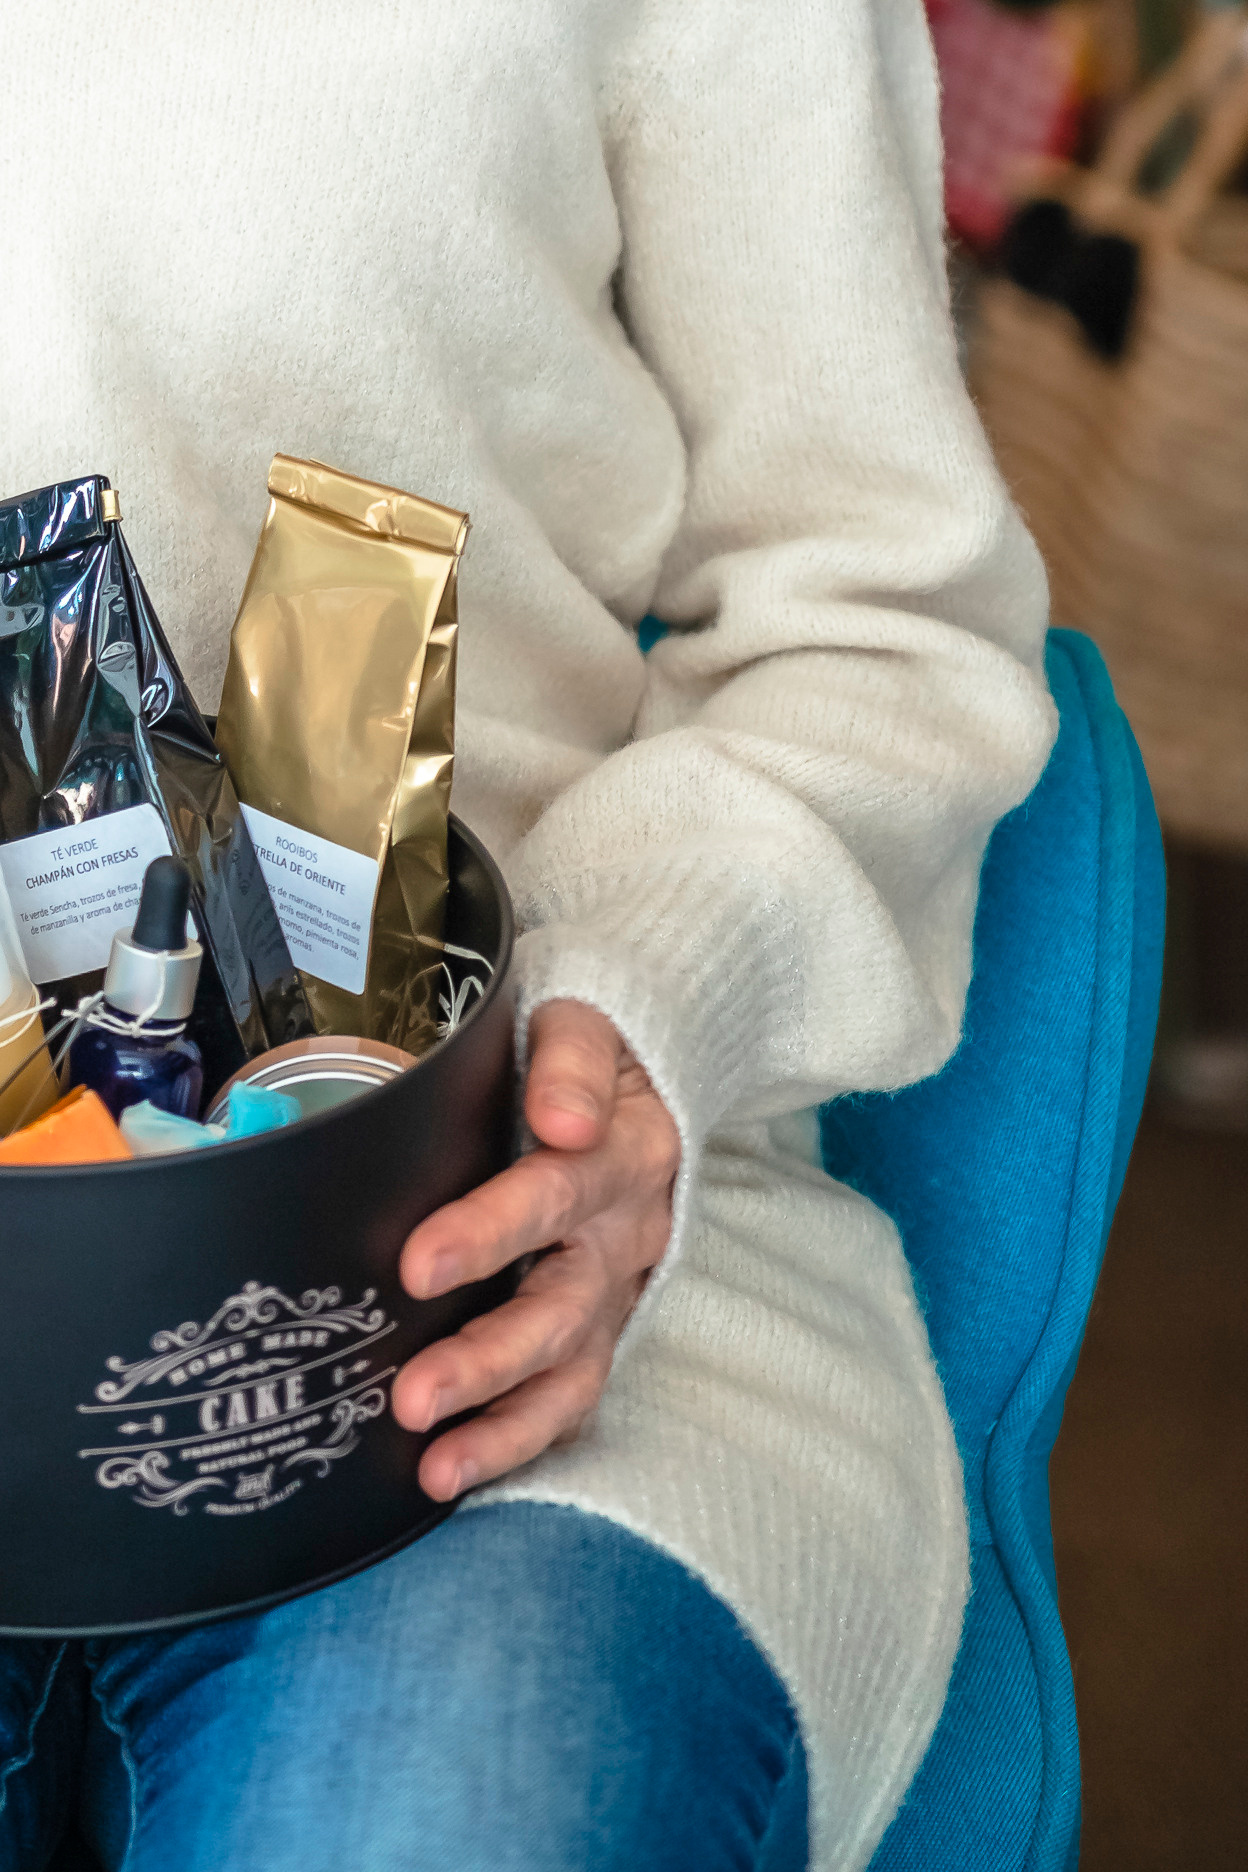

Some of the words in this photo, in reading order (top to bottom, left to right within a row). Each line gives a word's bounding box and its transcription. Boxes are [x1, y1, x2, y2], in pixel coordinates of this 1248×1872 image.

[24, 863, 75, 890] CHAMPÁN
[75, 858, 100, 875] CON
[99, 846, 139, 867] FRESAS
[49, 846, 64, 862] TÉ
[64, 838, 99, 858] VERDE
[253, 845, 287, 867] TRELLA
[290, 862, 302, 875] DE
[304, 868, 346, 894] ORIENTE
[275, 836, 319, 863] ROOIBOS
[19, 912, 29, 922] Té
[28, 907, 49, 921] verde
[48, 897, 79, 916] Sencha,
[79, 891, 105, 906] trozos
[104, 886, 116, 898] de
[116, 879, 140, 895] fresa,
[29, 925, 39, 936] de
[38, 913, 79, 933] manzanilla
[85, 905, 112, 920] aroma
[111, 899, 123, 912] de
[122, 894, 141, 908] cha
[278, 887, 286, 897] de
[351, 920, 361, 931] de
[279, 916, 304, 934] momo,
[199, 1374, 306, 1434] CAKE
